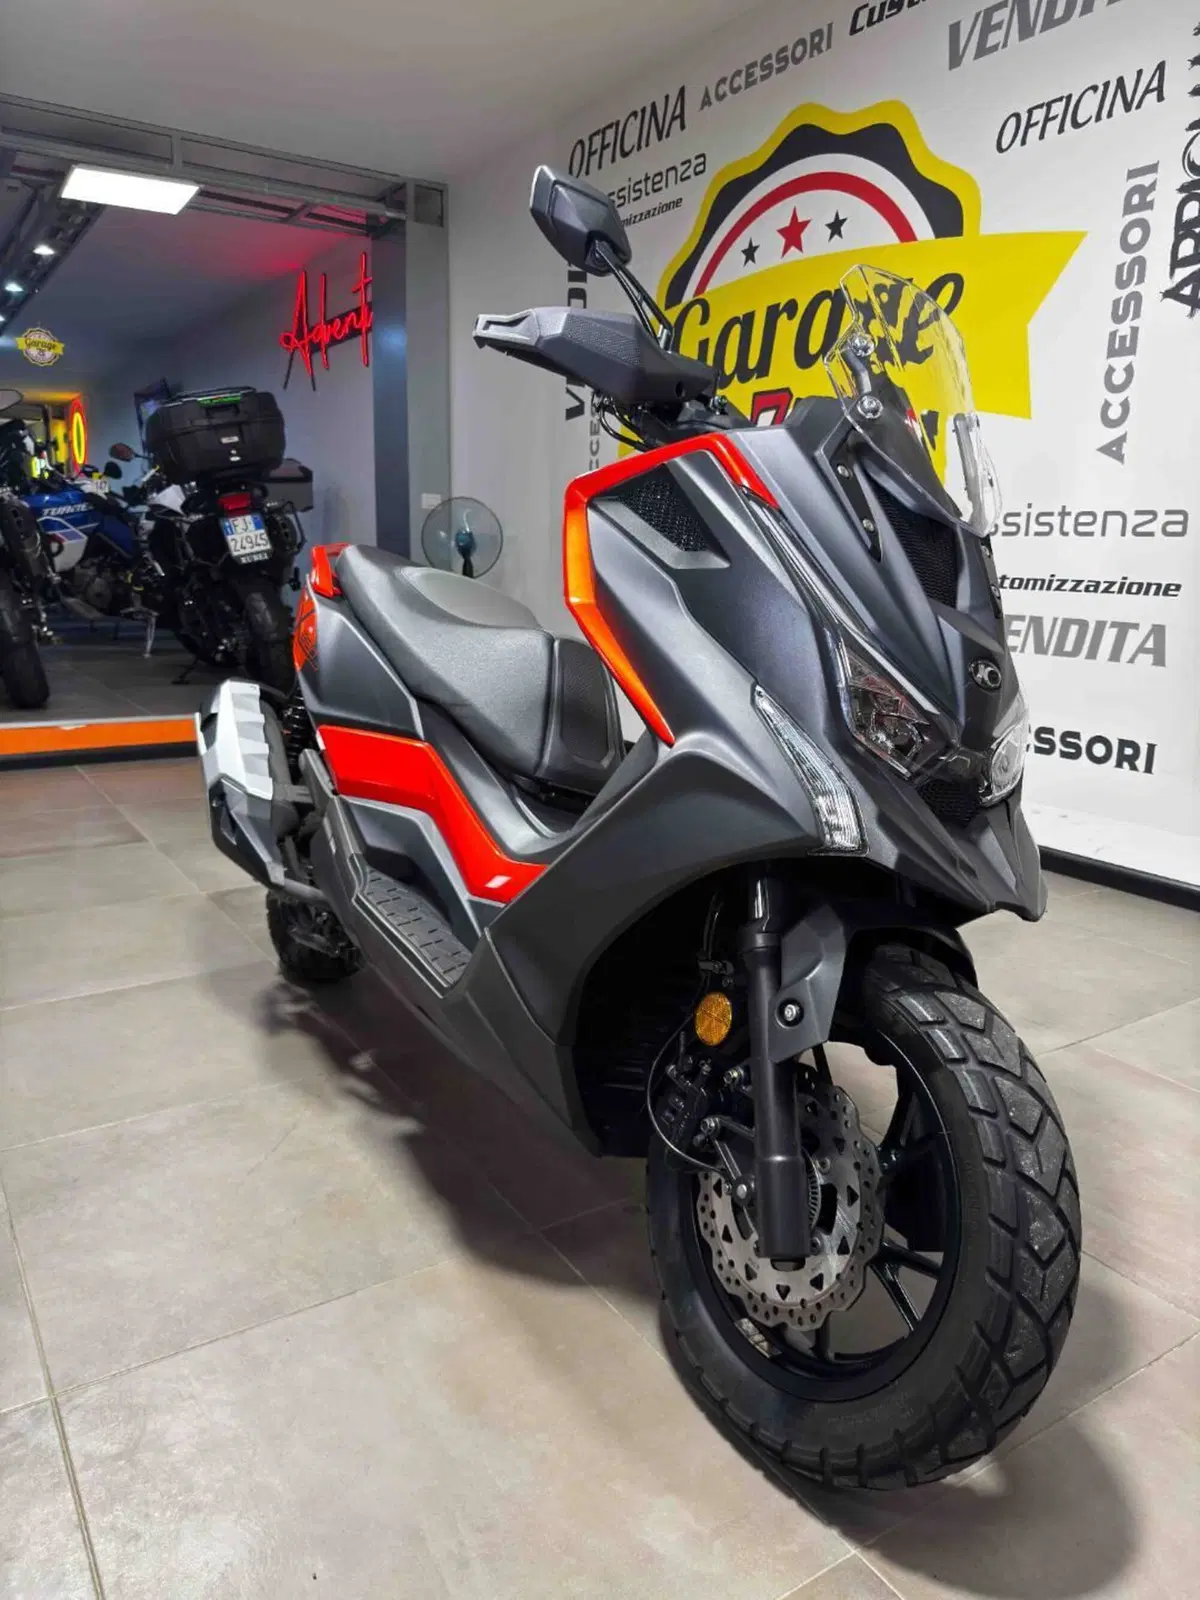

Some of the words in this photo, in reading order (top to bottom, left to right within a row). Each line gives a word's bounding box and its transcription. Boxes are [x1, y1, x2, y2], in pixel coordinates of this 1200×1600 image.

[699, 22, 834, 112] ACCESSORI
[948, 0, 1120, 71] VEND
[568, 85, 686, 179] OFFICINA
[996, 60, 1166, 154] OFFICINA
[1096, 160, 1160, 466] ACCESSORI
[990, 503, 1189, 537] sistenza
[998, 574, 1182, 598] tomizzazione
[1004, 614, 1167, 668] ENDITA
[1027, 724, 1158, 775] SSORI
